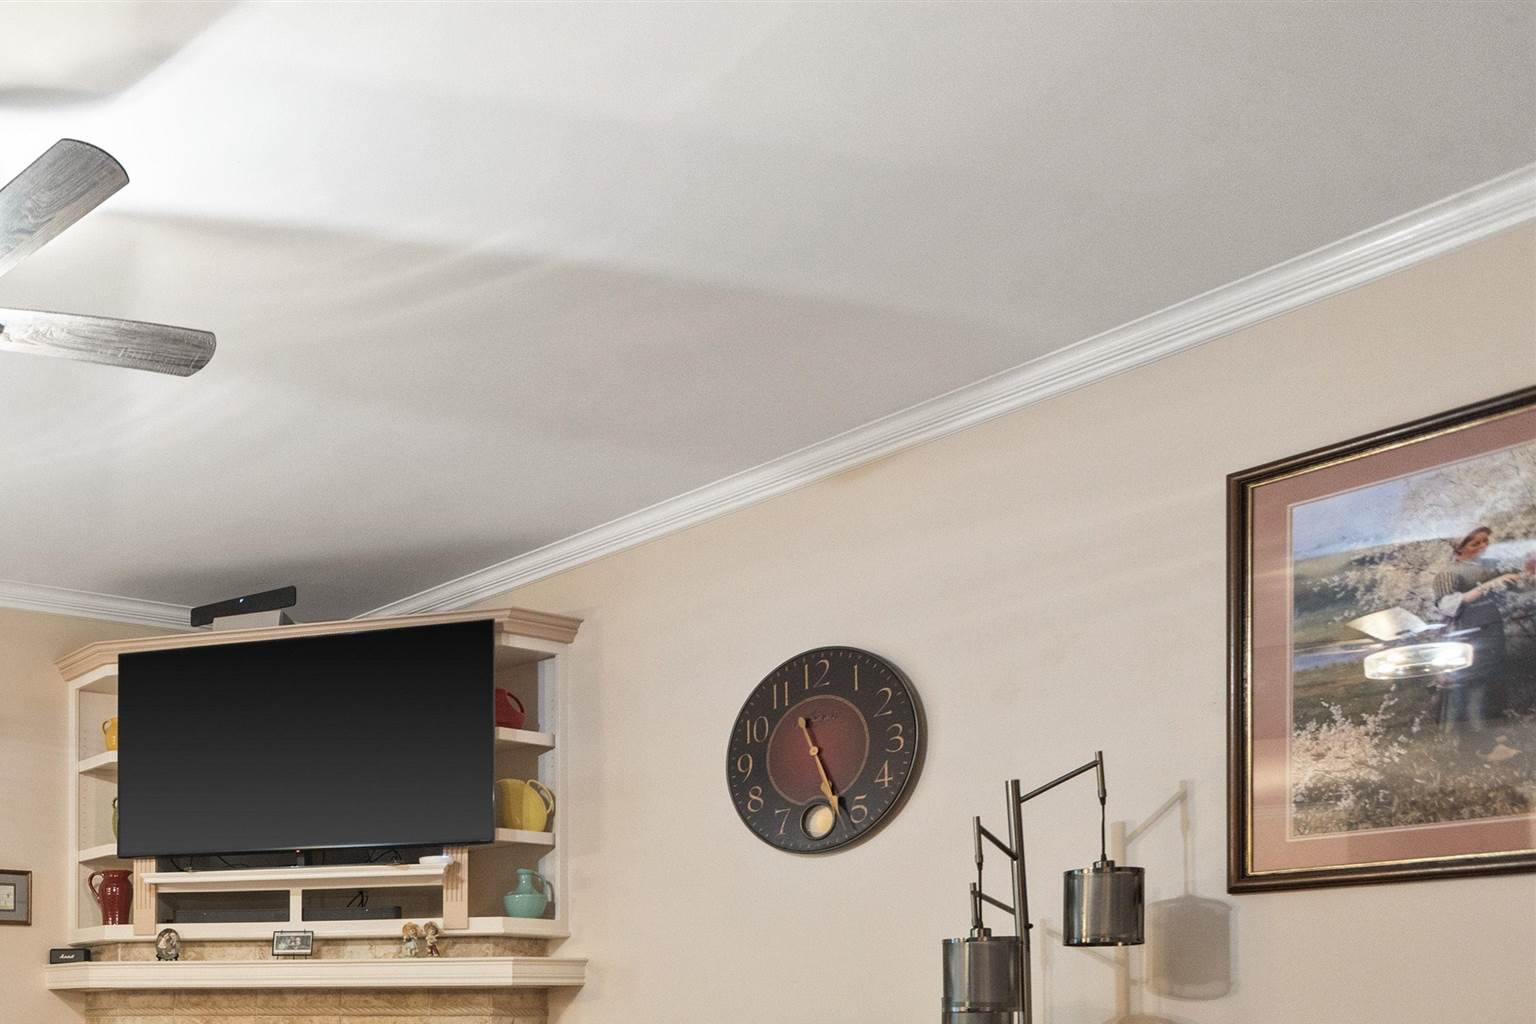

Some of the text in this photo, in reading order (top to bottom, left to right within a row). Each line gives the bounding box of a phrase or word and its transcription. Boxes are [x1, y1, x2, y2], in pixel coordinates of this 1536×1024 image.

[804, 659, 830, 690] 12
[853, 664, 859, 691] 1
[772, 681, 789, 710] 11
[873, 687, 893, 718] 2
[746, 715, 769, 744] 10
[885, 723, 904, 753] 3
[737, 753, 753, 783] 9
[874, 760, 893, 788] 4
[747, 786, 764, 813] 8
[850, 794, 868, 824] 5
[775, 808, 792, 835] 7
